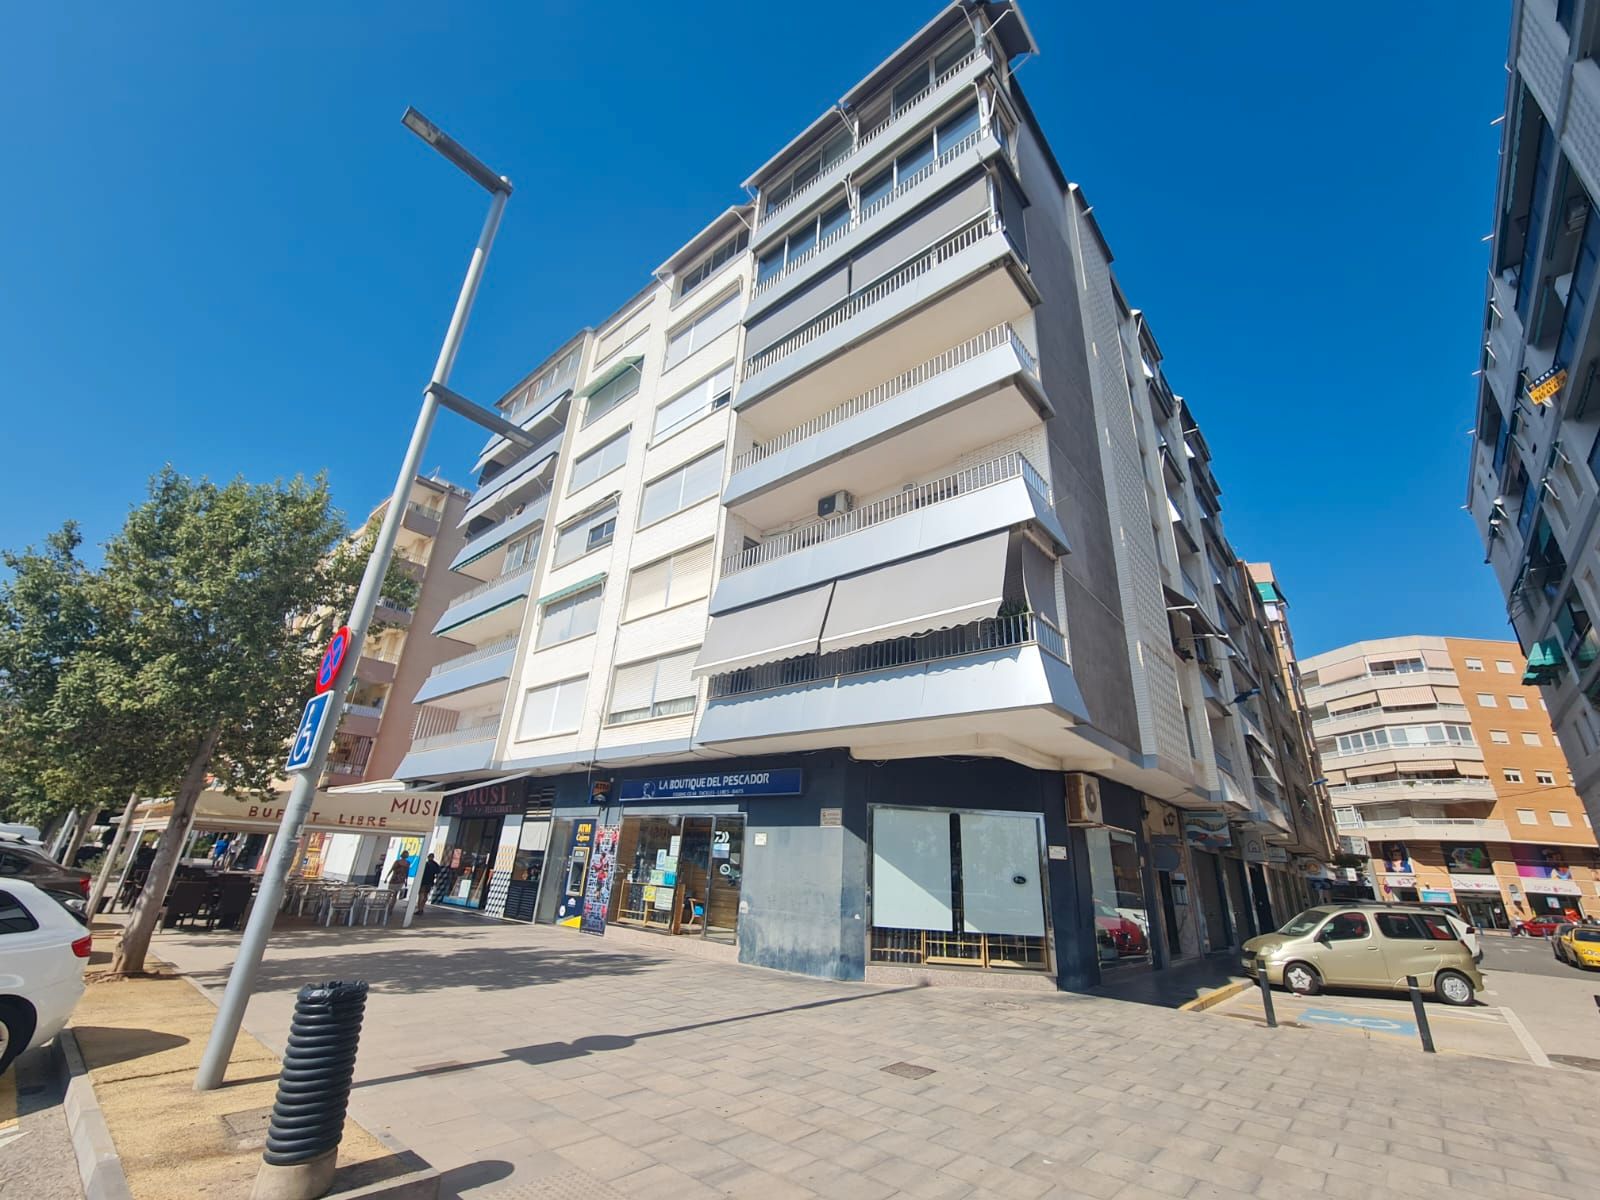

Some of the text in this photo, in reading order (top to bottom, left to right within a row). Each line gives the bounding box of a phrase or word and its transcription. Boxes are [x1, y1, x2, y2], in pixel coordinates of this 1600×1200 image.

[658, 772, 770, 790] LA BOUTIQUE DEL PESCADOR
[465, 784, 508, 806] MUSI
[248, 805, 388, 827] BUFT LIBRE
[390, 797, 439, 817] MUSI
[577, 823, 592, 833] ATM
